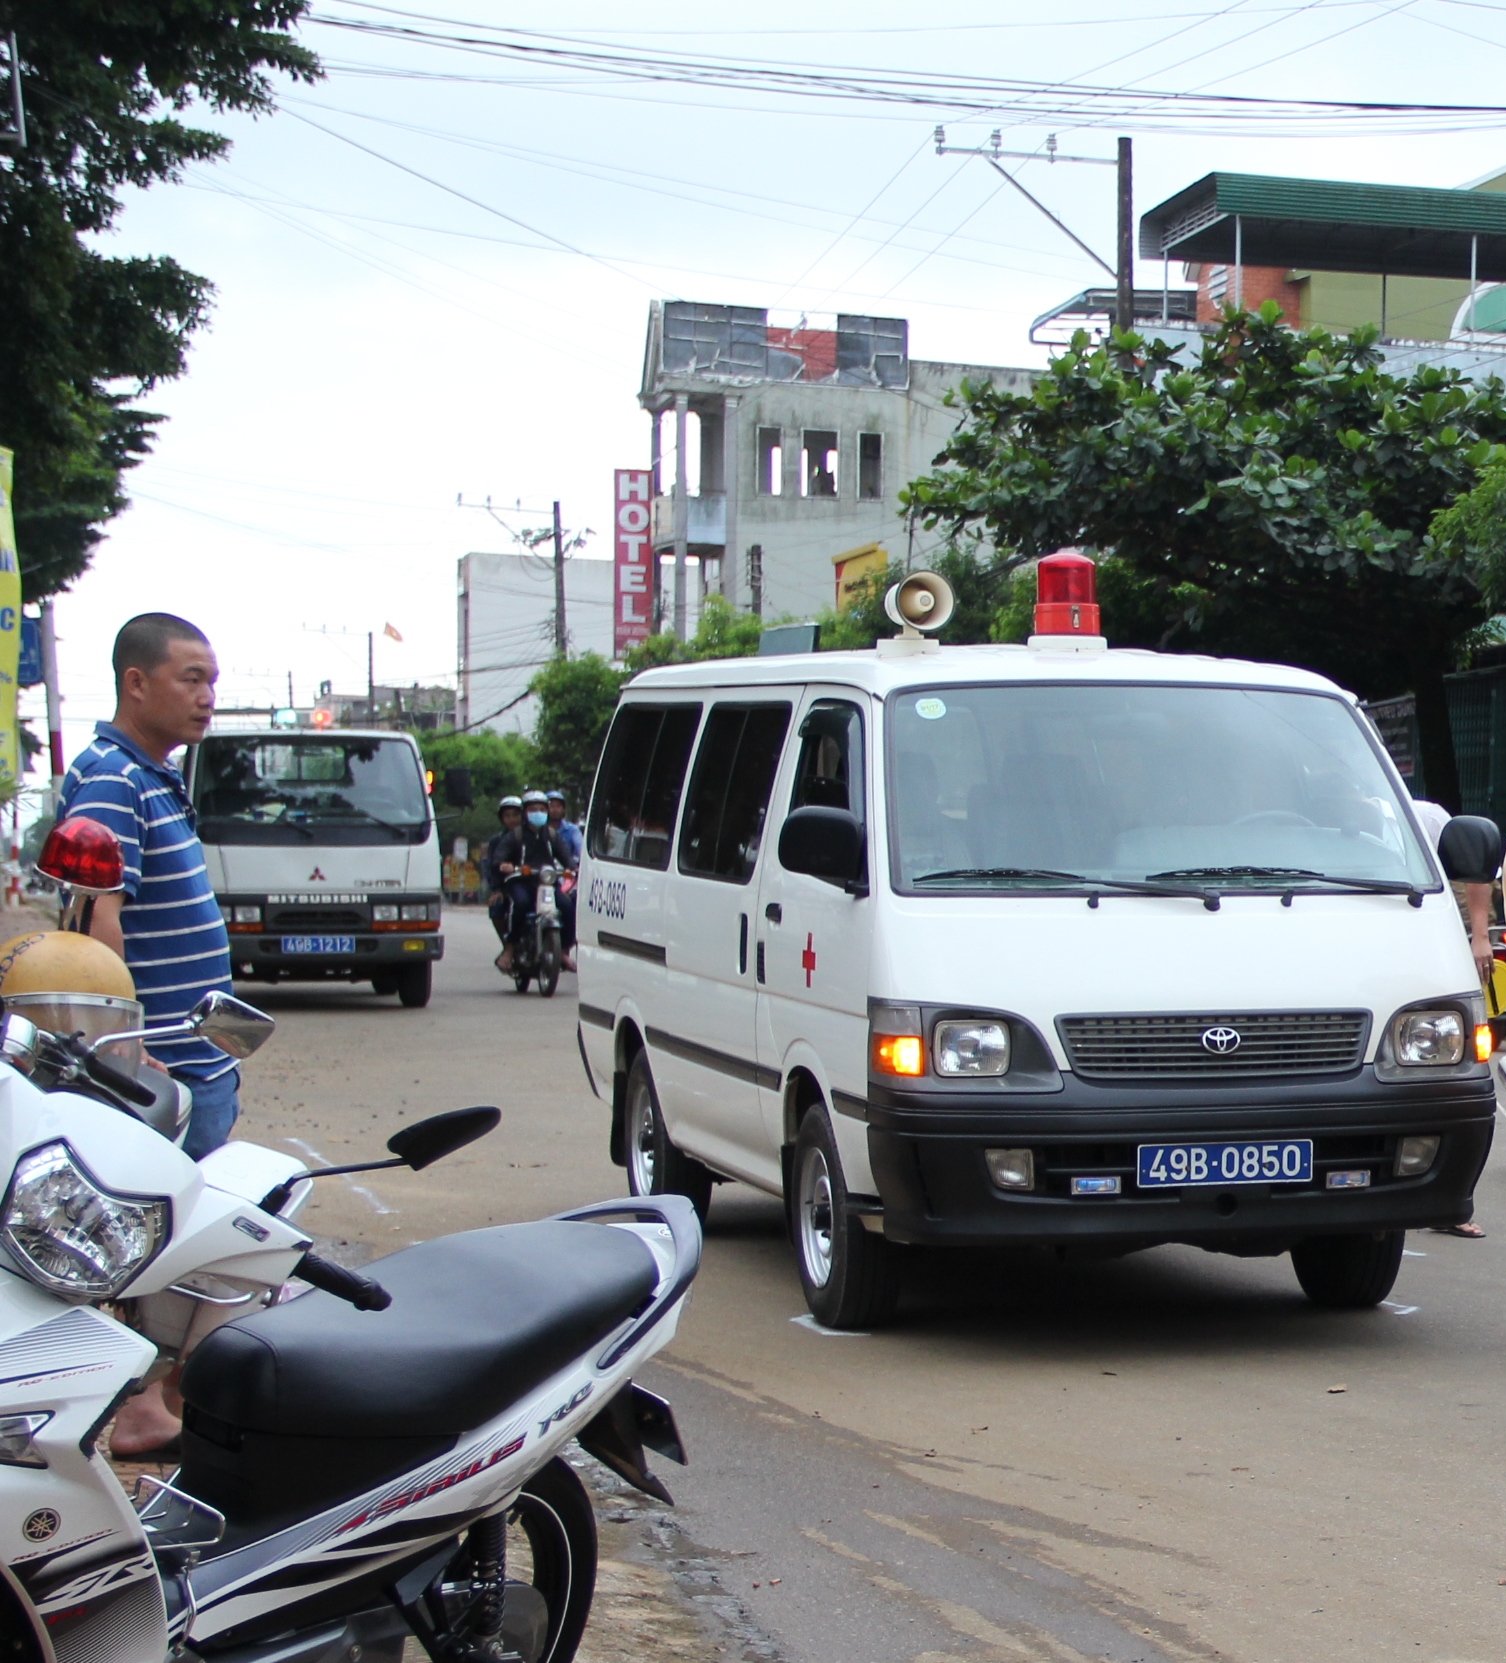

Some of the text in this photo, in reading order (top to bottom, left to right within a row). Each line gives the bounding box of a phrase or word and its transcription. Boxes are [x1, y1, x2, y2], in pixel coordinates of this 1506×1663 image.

[618, 473, 650, 624] HOTEL
[267, 894, 369, 904] MITSUBISHI
[1149, 1144, 1301, 1182] 49B-0850
